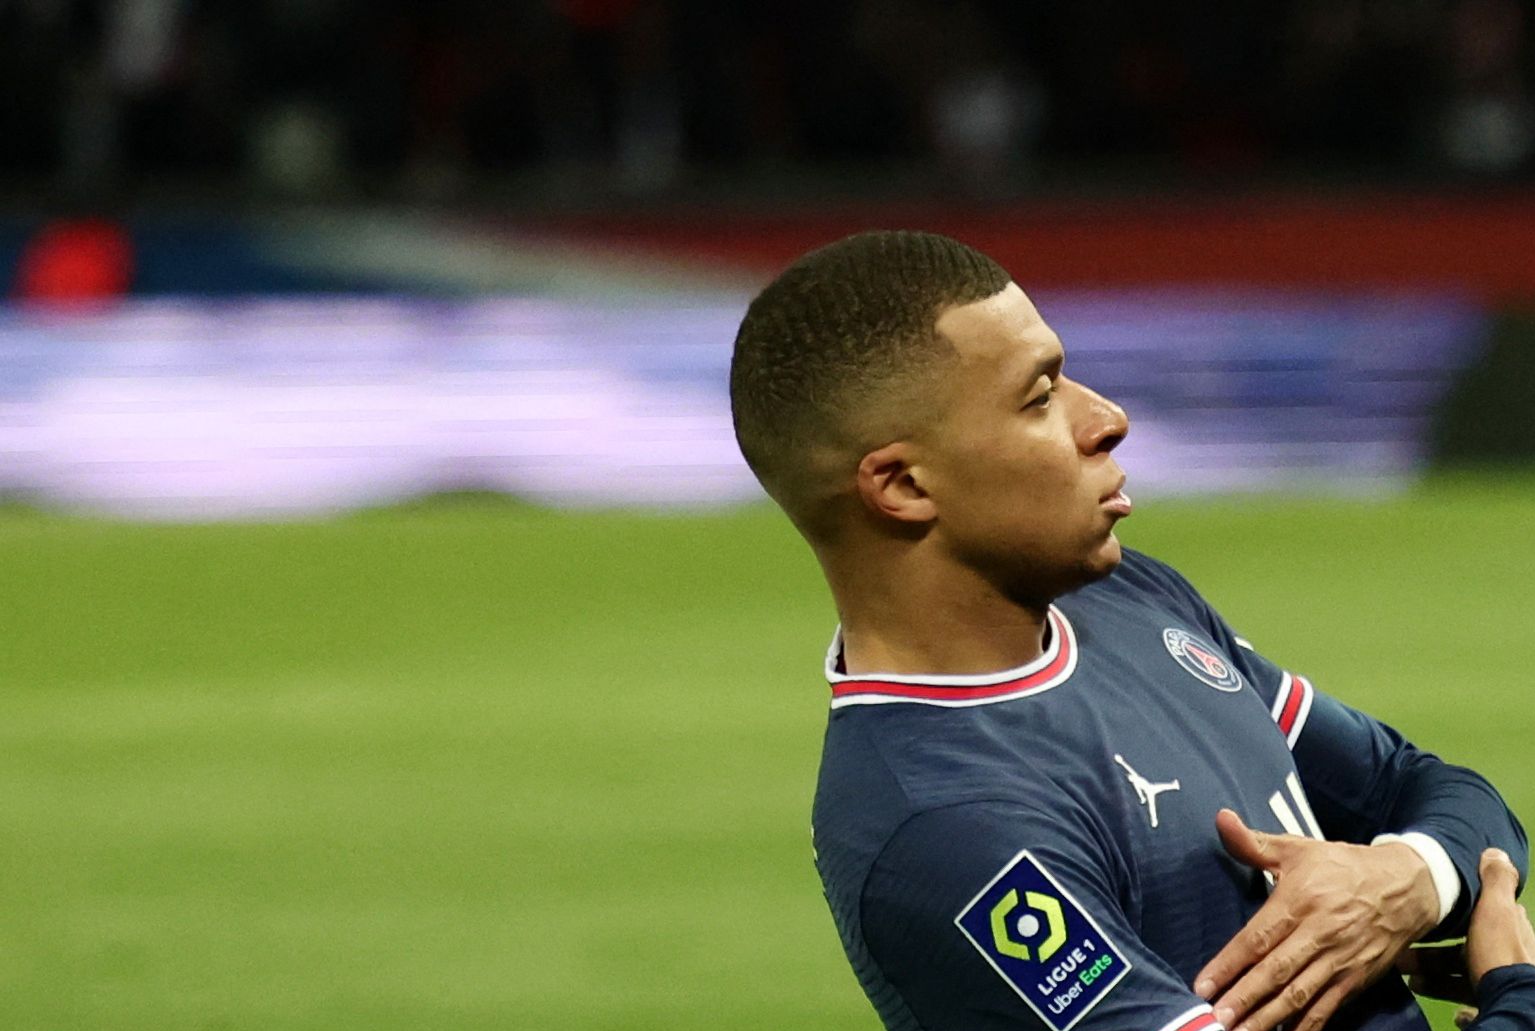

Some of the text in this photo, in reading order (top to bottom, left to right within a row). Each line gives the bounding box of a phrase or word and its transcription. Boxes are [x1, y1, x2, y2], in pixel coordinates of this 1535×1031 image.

[1038, 939, 1095, 996] LIGUE 1
[1048, 954, 1112, 1014] Uber Eats
